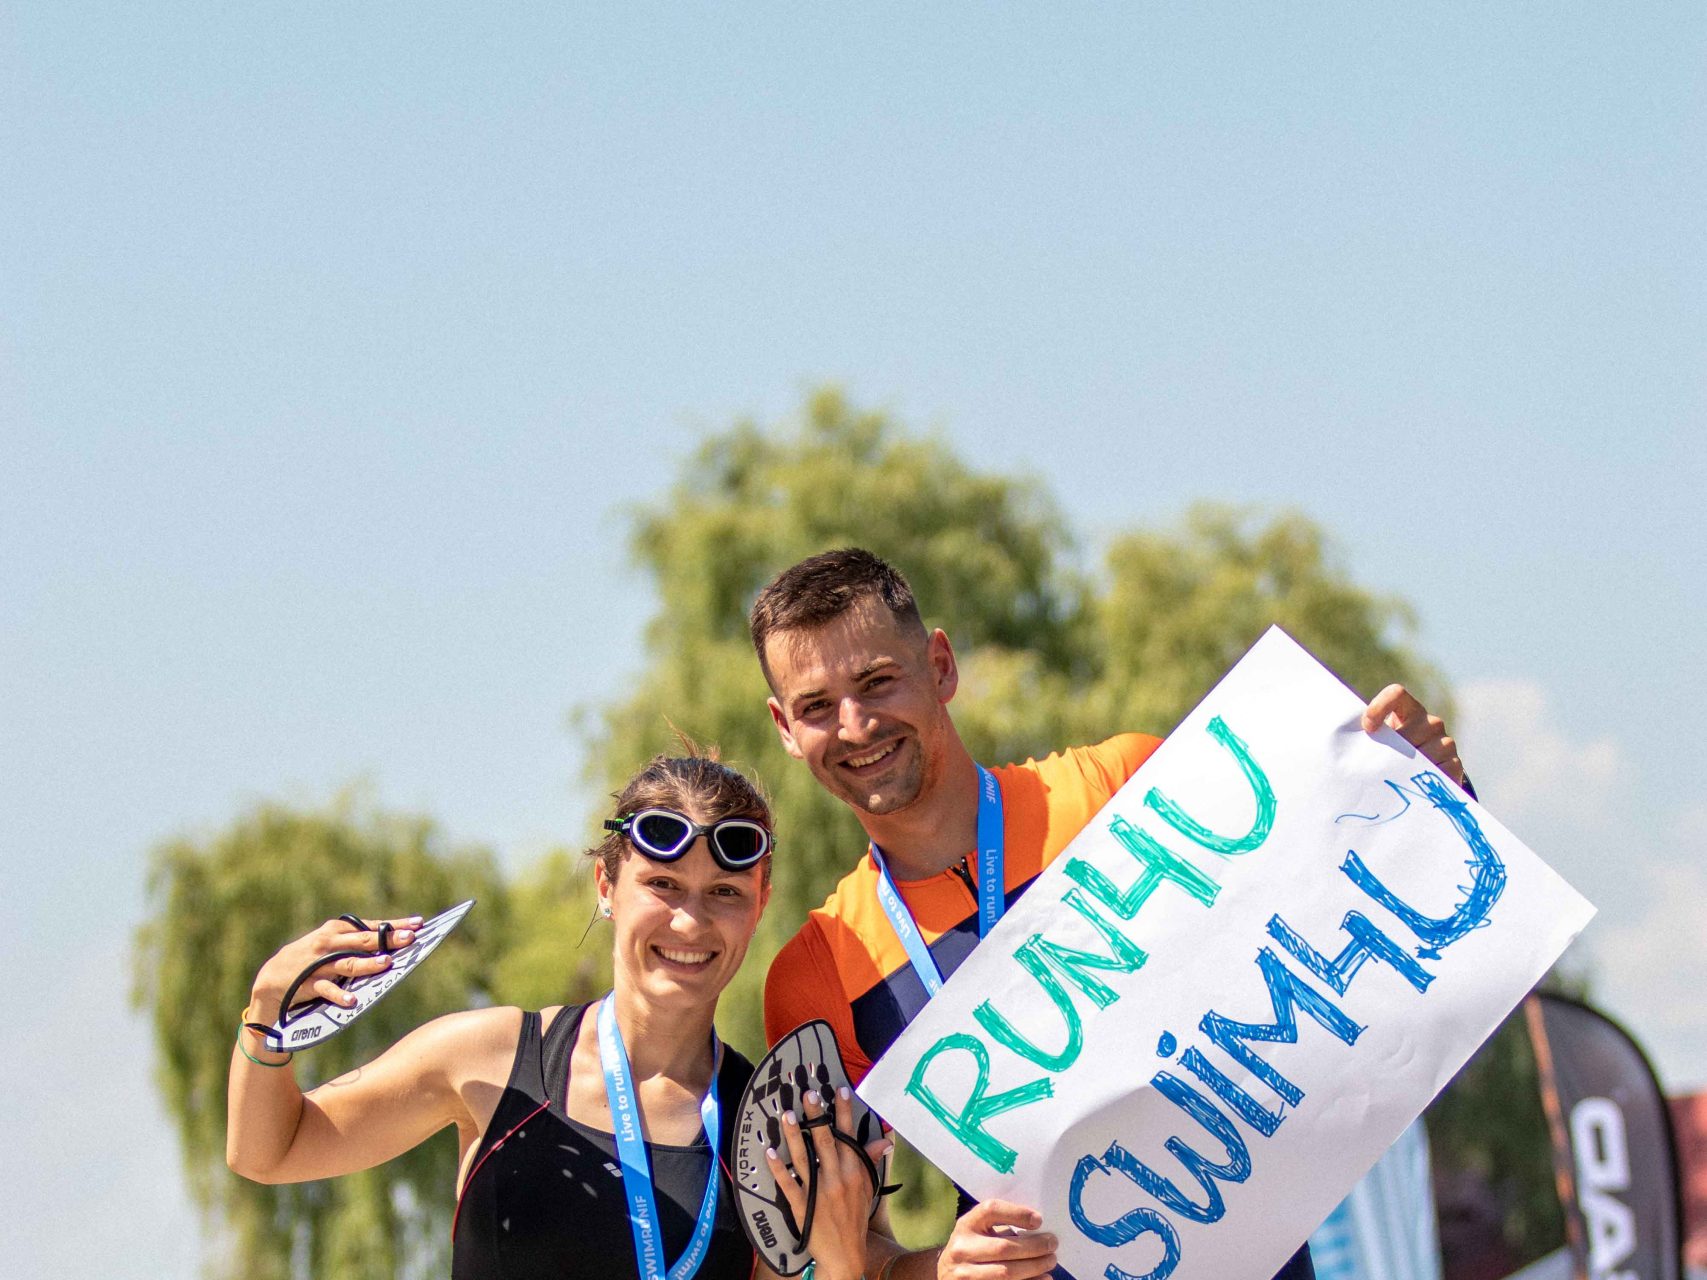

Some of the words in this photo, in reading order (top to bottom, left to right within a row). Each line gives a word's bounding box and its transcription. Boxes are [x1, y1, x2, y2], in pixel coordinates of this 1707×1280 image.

[985, 849, 997, 876] Live
[985, 878, 996, 893] to
[905, 714, 1277, 1174] RUN4U
[291, 1025, 322, 1042] arena
[618, 1093, 629, 1110] to
[622, 1112, 635, 1143] Live
[739, 1110, 755, 1181] VORTEX
[751, 1210, 778, 1250] arena
